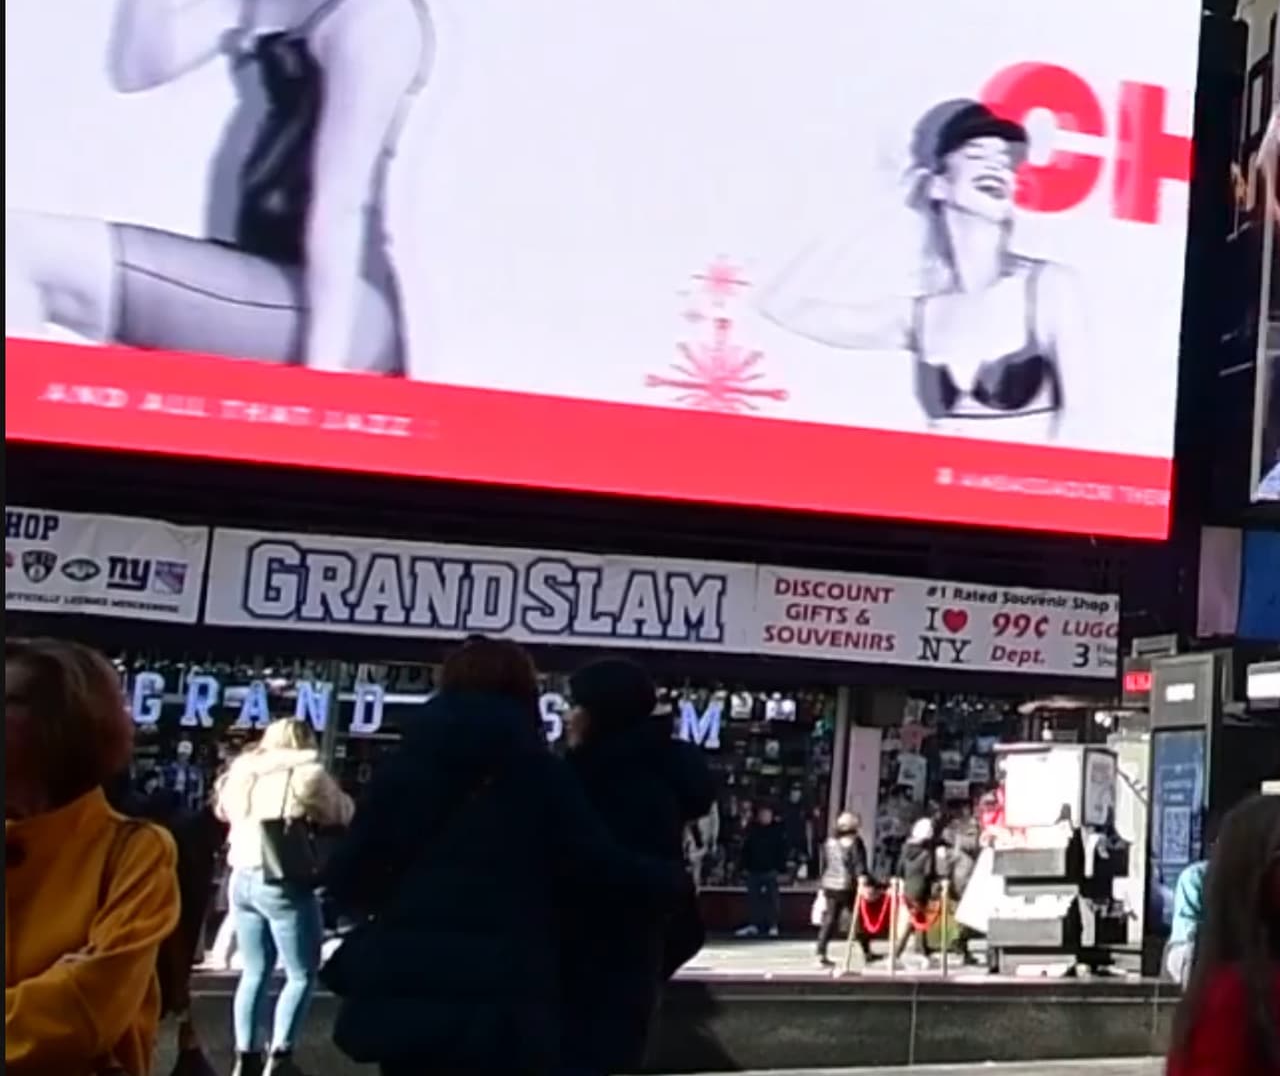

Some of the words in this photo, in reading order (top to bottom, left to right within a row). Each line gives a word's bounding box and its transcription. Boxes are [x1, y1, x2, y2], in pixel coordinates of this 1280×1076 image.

[5, 511, 60, 541] HOP
[774, 577, 895, 604] DISCOUNT
[926, 585, 946, 599] #1
[953, 587, 997, 604] Rated
[1002, 591, 1067, 608] Souvenir
[1072, 597, 1110, 614] Shop
[785, 603, 848, 624] GIFTS
[855, 608, 870, 625] &
[925, 607, 940, 632] I
[992, 612, 1050, 638] 99¢
[763, 625, 896, 652] SOUVENIRS
[918, 635, 972, 664] NY
[990, 645, 1046, 667] Dept.
[1072, 643, 1090, 668] 3
[132, 671, 385, 734] GRAND
